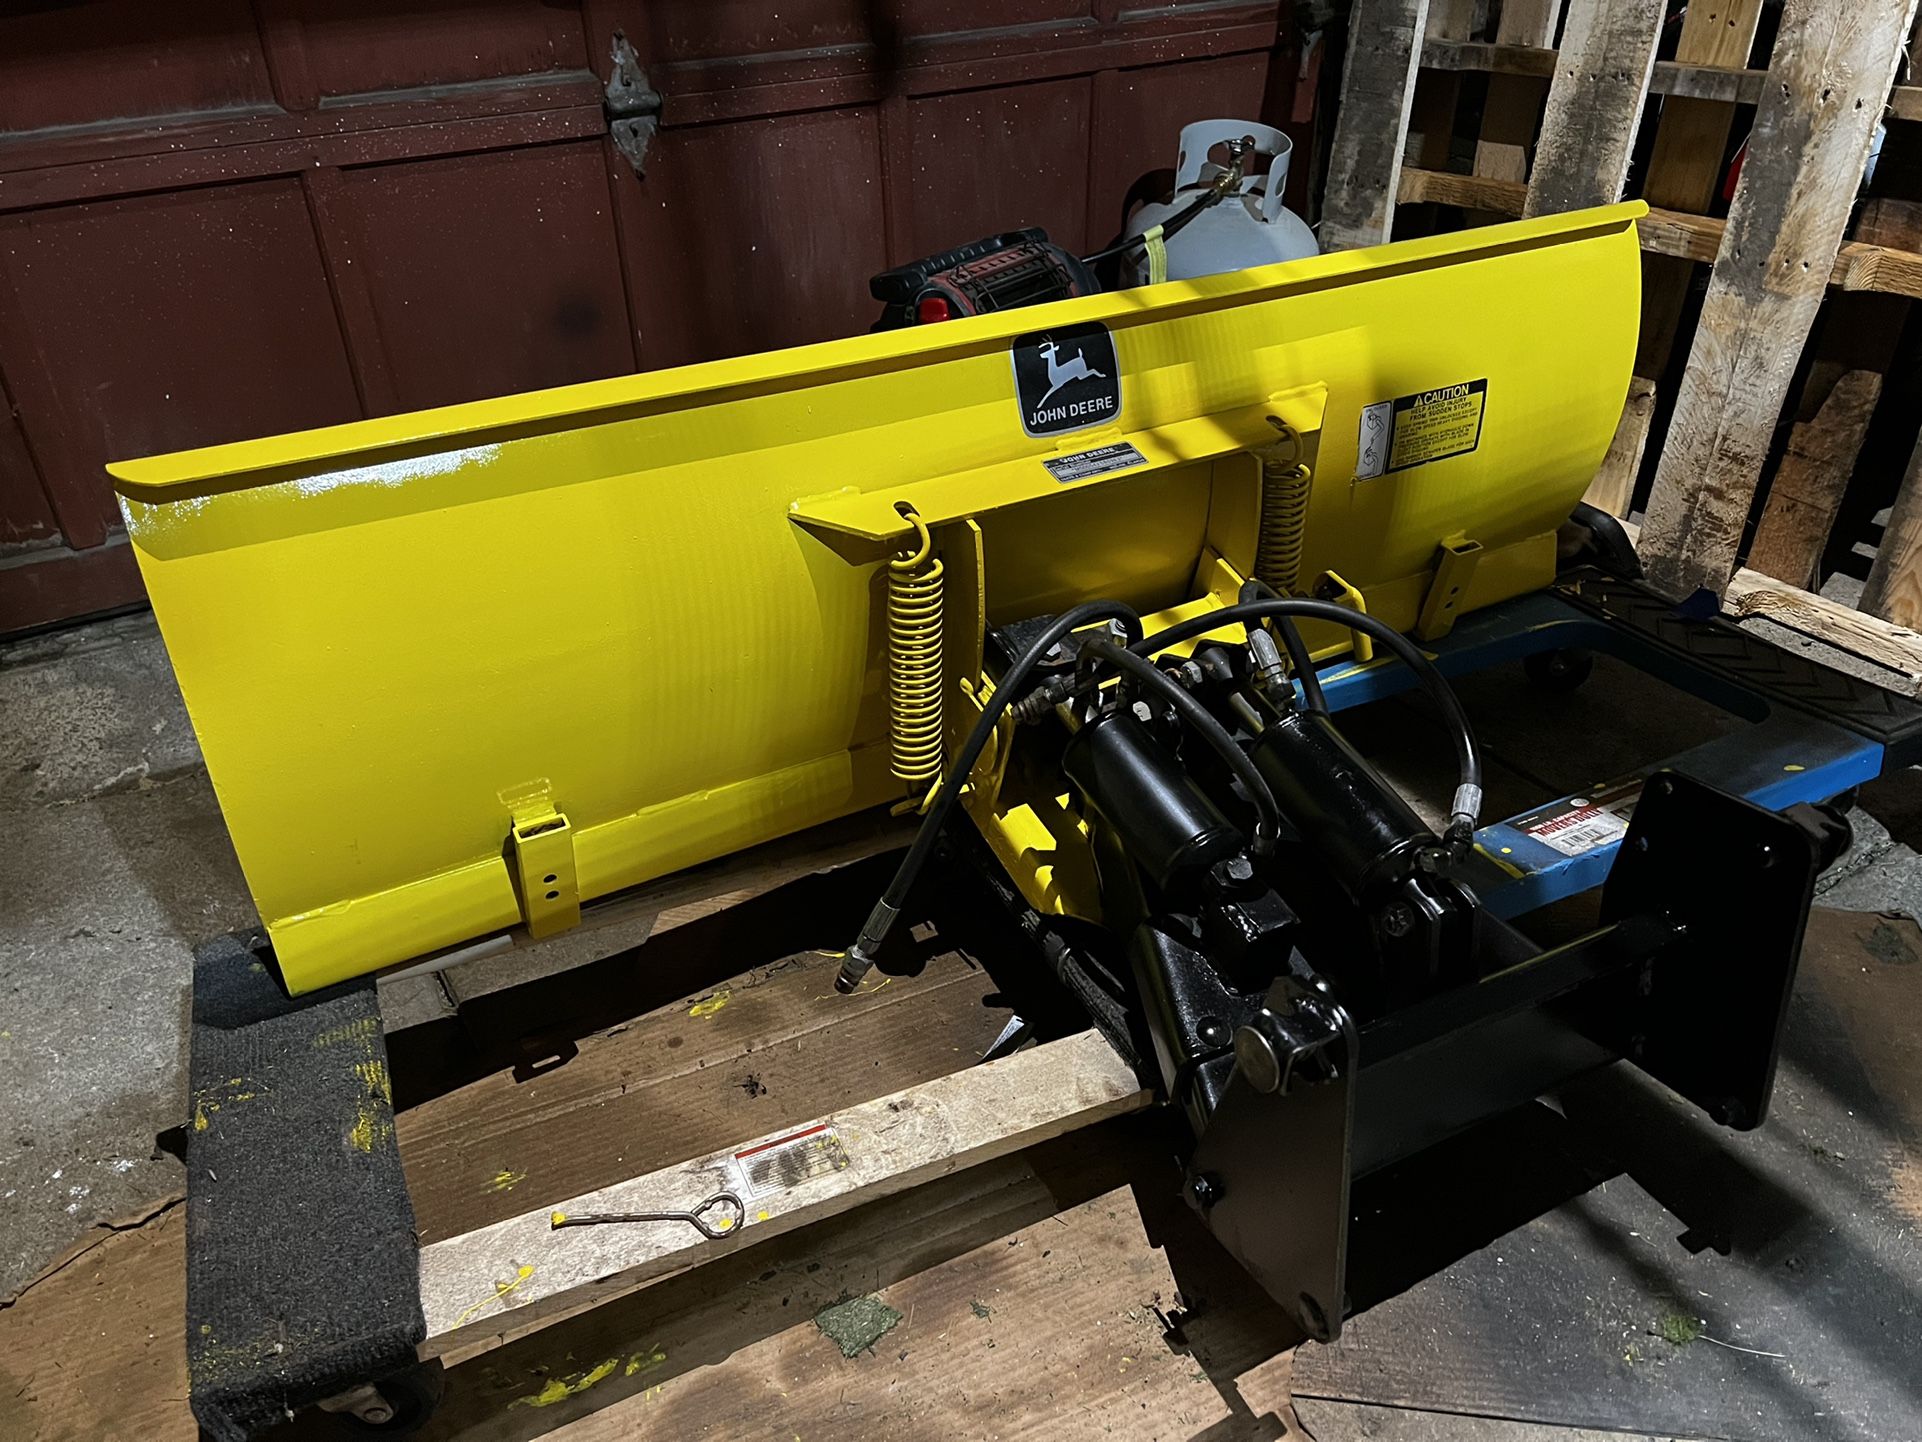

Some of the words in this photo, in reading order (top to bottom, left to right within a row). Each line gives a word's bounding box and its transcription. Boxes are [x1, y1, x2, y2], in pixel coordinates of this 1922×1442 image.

[1424, 384, 1469, 405] CAUTION
[1428, 402, 1445, 410] AVOID
[1447, 397, 1467, 405] INJURY
[1030, 406, 1066, 426] JOHN
[1069, 396, 1113, 417] DEERE
[1410, 413, 1426, 421] FROM
[1429, 406, 1452, 417] SUDDEN
[1454, 401, 1472, 410] STOPS
[1060, 454, 1086, 464] JOHN
[1087, 447, 1116, 458] DEERE
